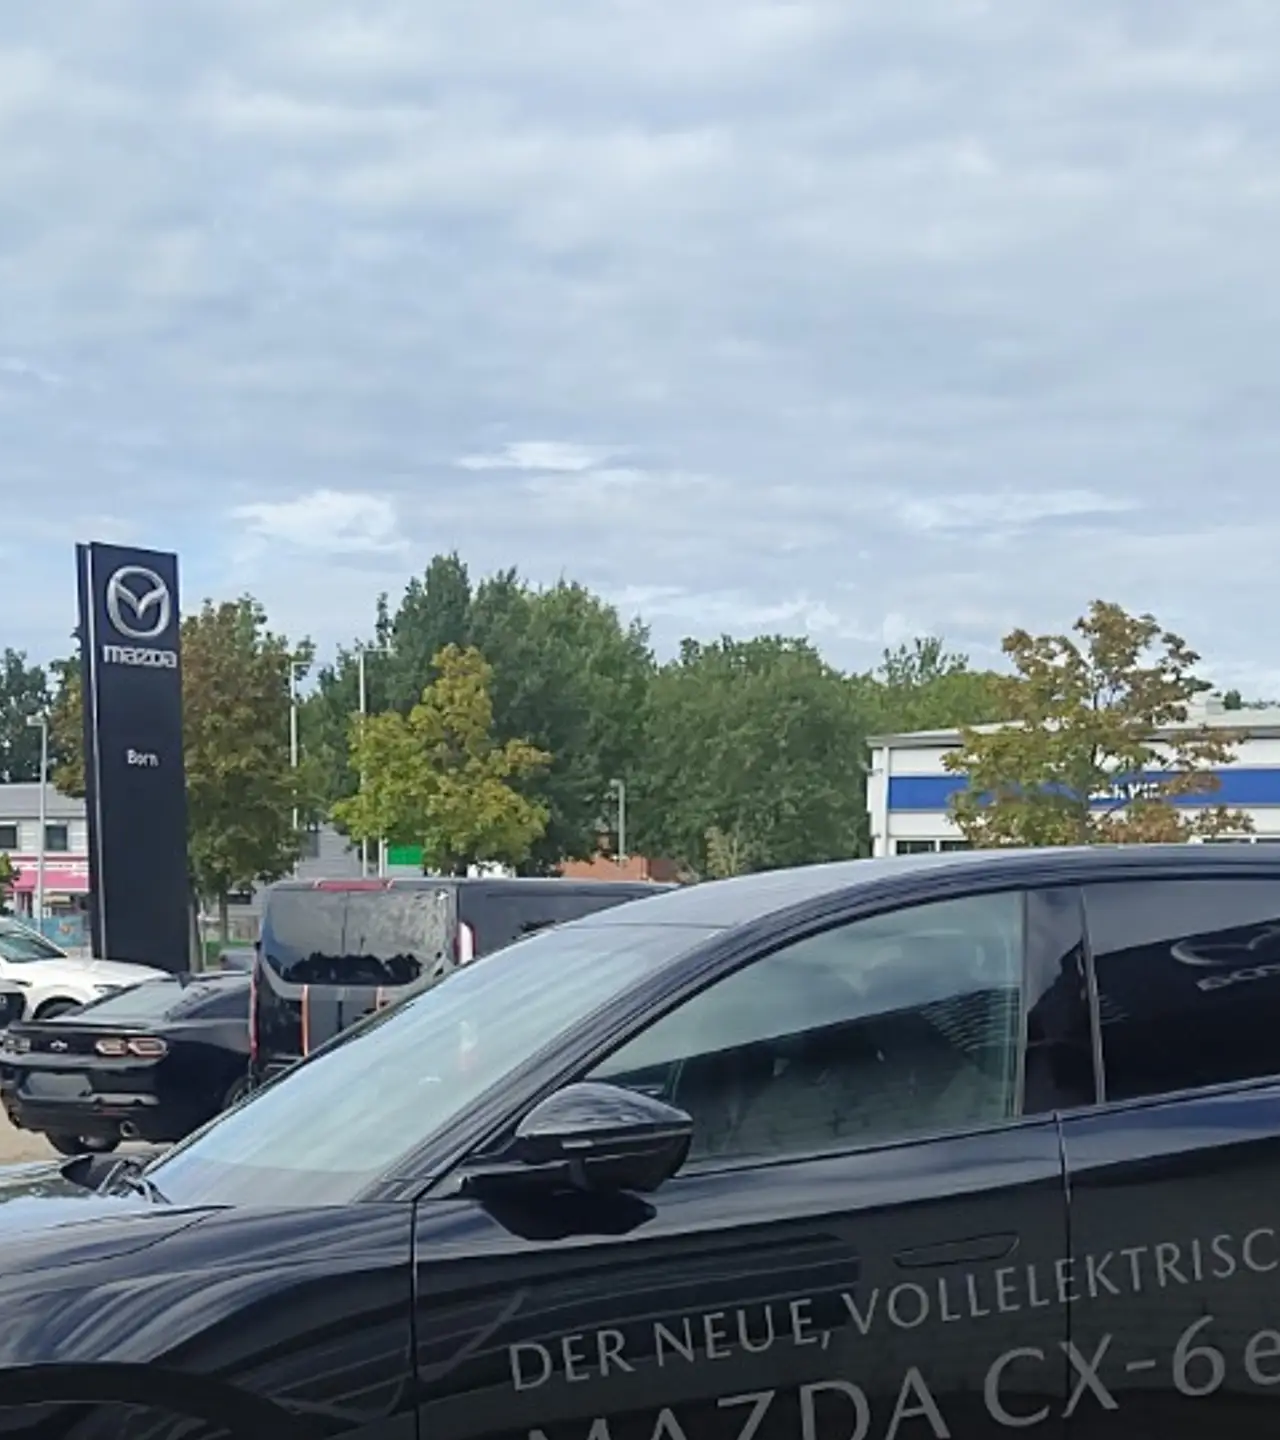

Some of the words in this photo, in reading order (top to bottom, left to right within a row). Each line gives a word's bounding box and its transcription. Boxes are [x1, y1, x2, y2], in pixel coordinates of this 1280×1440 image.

[103, 645, 177, 668] mazda
[127, 749, 159, 767] Born
[509, 1329, 637, 1392] DER
[653, 1298, 831, 1368] NEUE,
